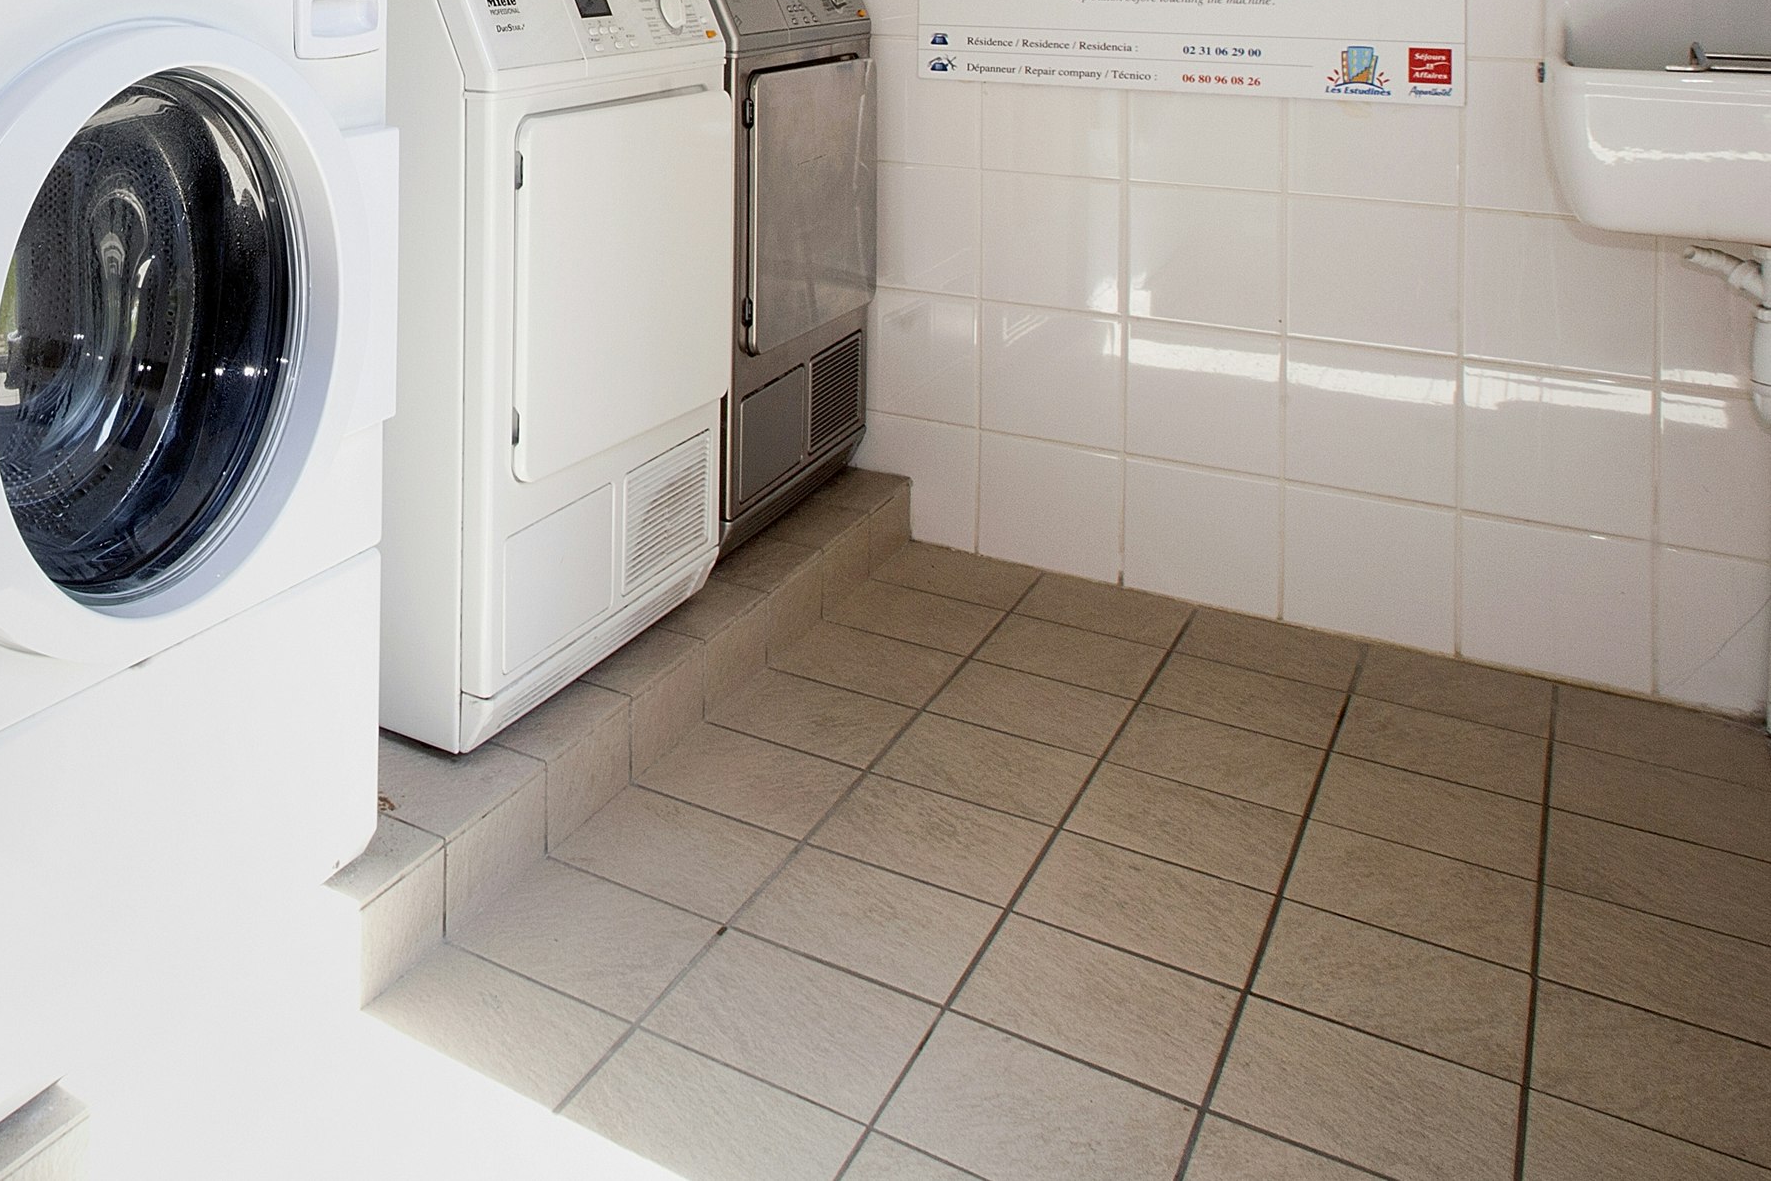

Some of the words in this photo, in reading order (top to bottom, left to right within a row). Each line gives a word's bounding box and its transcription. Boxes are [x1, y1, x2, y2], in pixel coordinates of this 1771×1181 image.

[966, 36, 1013, 47] Résidence
[1021, 38, 1070, 49] Residence
[1079, 40, 1132, 52] Residencia
[1182, 45, 1196, 55] 02
[1198, 45, 1210, 55] 31
[1214, 46, 1228, 55] 06
[1231, 47, 1245, 56] 29
[1247, 48, 1261, 57] 00
[966, 62, 1016, 74] Dépanneur
[1024, 65, 1056, 77] Repair
[1057, 69, 1102, 80] company
[1110, 69, 1151, 80] Técnico
[1181, 73, 1195, 82] 06
[1197, 74, 1211, 83] 80
[1213, 75, 1228, 84] 96
[1230, 76, 1244, 85] 08
[1246, 76, 1261, 86] 26
[1325, 85, 1342, 94] Les
